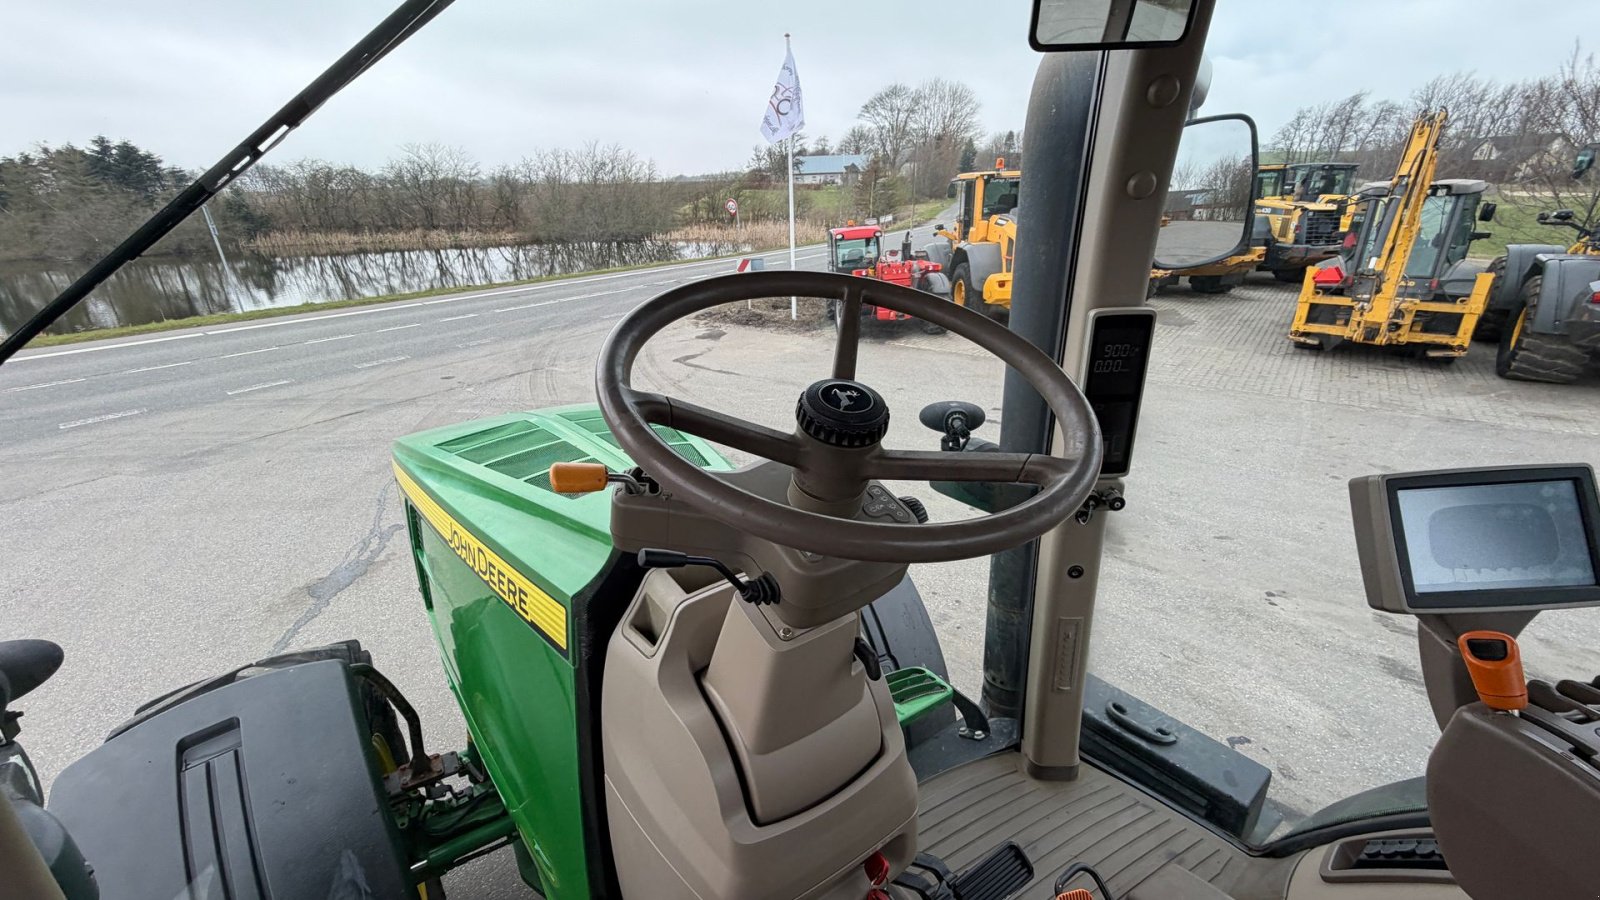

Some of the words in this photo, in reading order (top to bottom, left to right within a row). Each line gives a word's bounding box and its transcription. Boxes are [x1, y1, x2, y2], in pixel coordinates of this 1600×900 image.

[1104, 344, 1130, 358] 900
[448, 521, 477, 570] JOHN
[477, 546, 530, 617] DEERE
